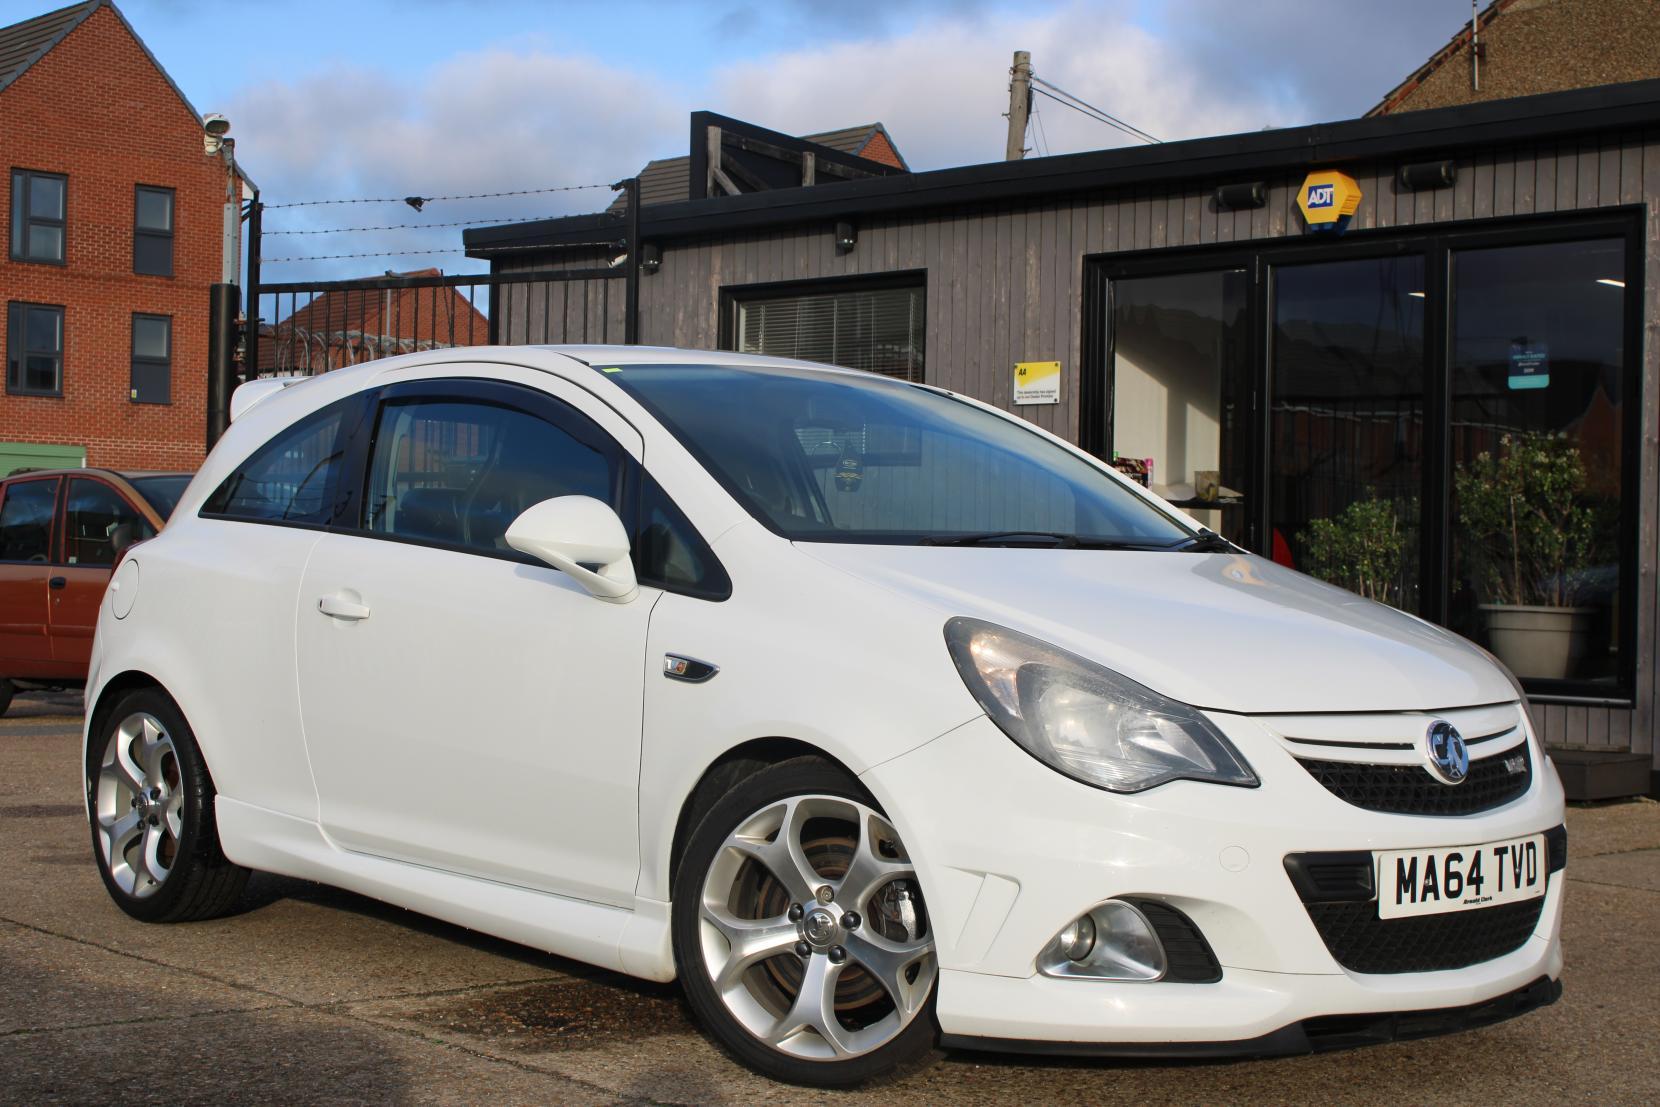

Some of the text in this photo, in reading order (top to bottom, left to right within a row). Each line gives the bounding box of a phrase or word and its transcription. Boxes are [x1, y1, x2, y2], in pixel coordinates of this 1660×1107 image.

[1308, 187, 1334, 206] ADT
[1018, 368, 1027, 376] AA
[1396, 841, 1537, 905] MA64 TVD
